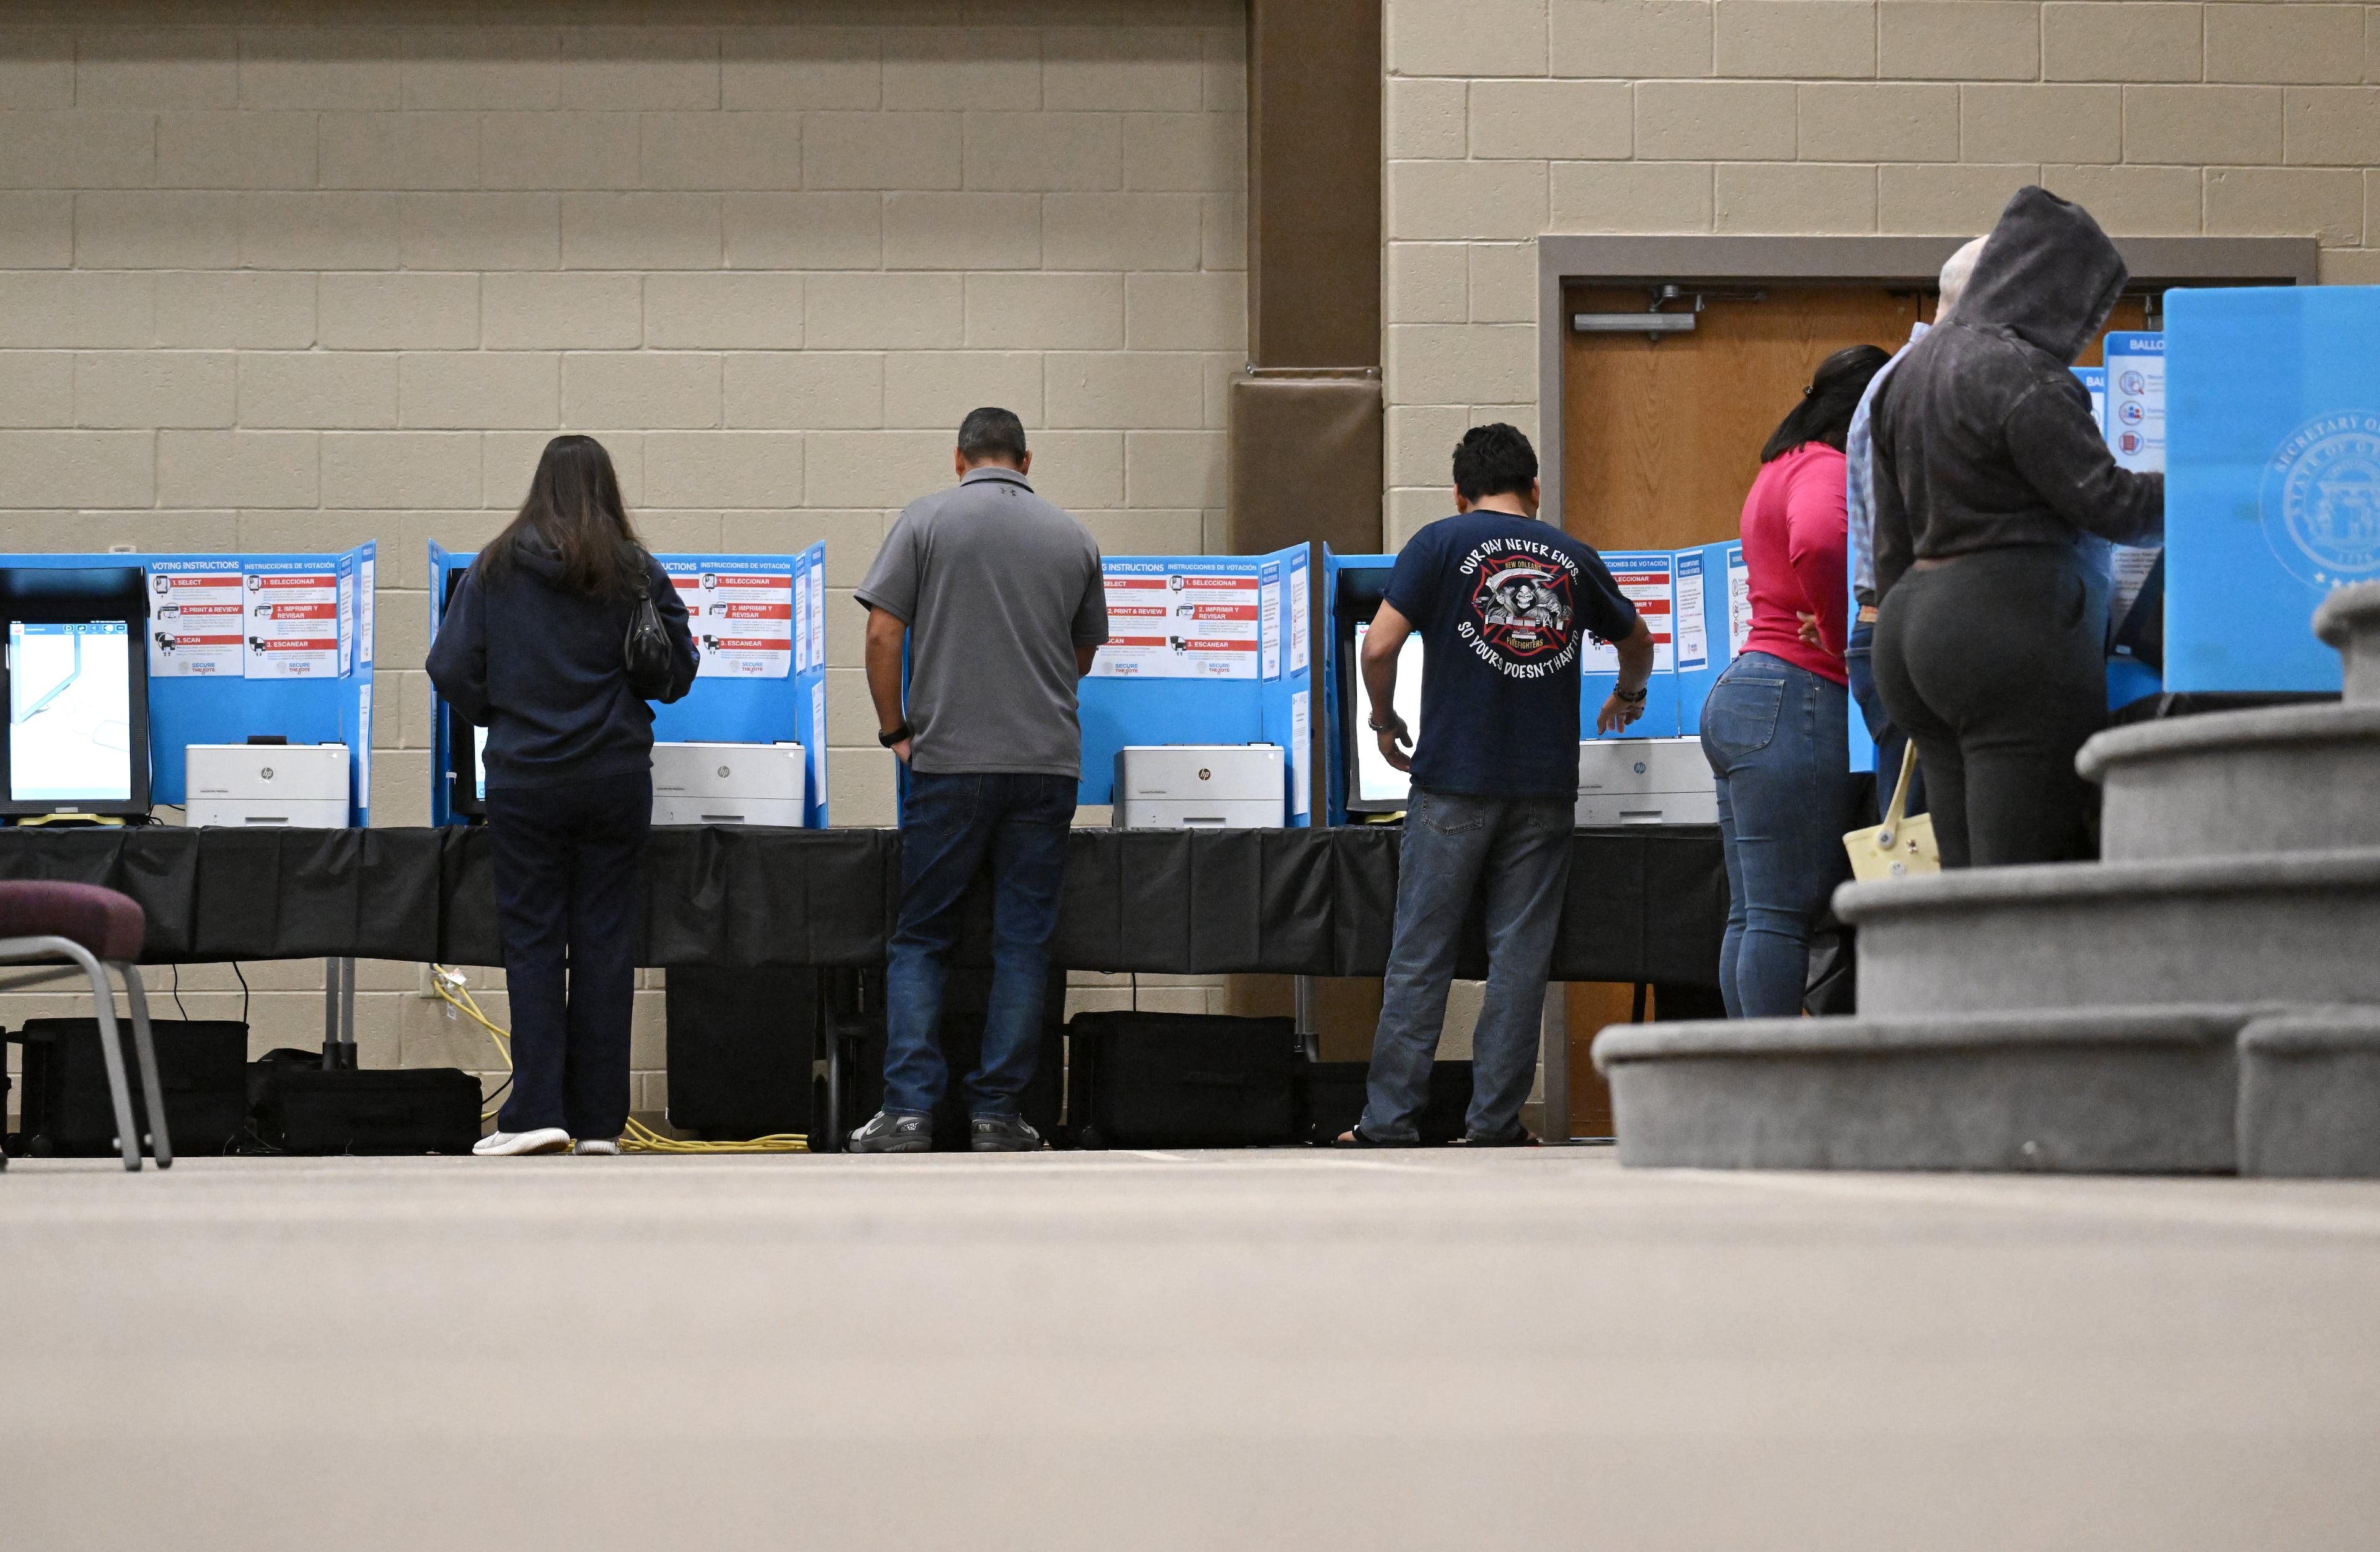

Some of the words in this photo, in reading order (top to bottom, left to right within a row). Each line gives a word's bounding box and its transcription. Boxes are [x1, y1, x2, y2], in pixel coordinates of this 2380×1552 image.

[2274, 415, 2359, 474] SECRETARY
[2365, 418, 2380, 433] O
[1460, 549, 1486, 575] OUR
[1481, 539, 1502, 555] DAY
[1505, 538, 1549, 557] NEVER
[152, 562, 182, 570] VOTING
[183, 561, 239, 570] INSTRUCTIONS
[1109, 563, 1164, 571] INSTRUCTIONS
[1517, 561, 1542, 571] ORLEANS
[1457, 621, 1475, 638] SO
[1470, 635, 1503, 671] YOURS
[1504, 659, 1554, 679] DOESN'T
[1506, 637, 1543, 650] FIREFIGHTERS
[261, 767, 274, 780] hp
[717, 765, 730, 778] hp
[1198, 768, 1211, 781] hp
[1634, 762, 1646, 774] hp
